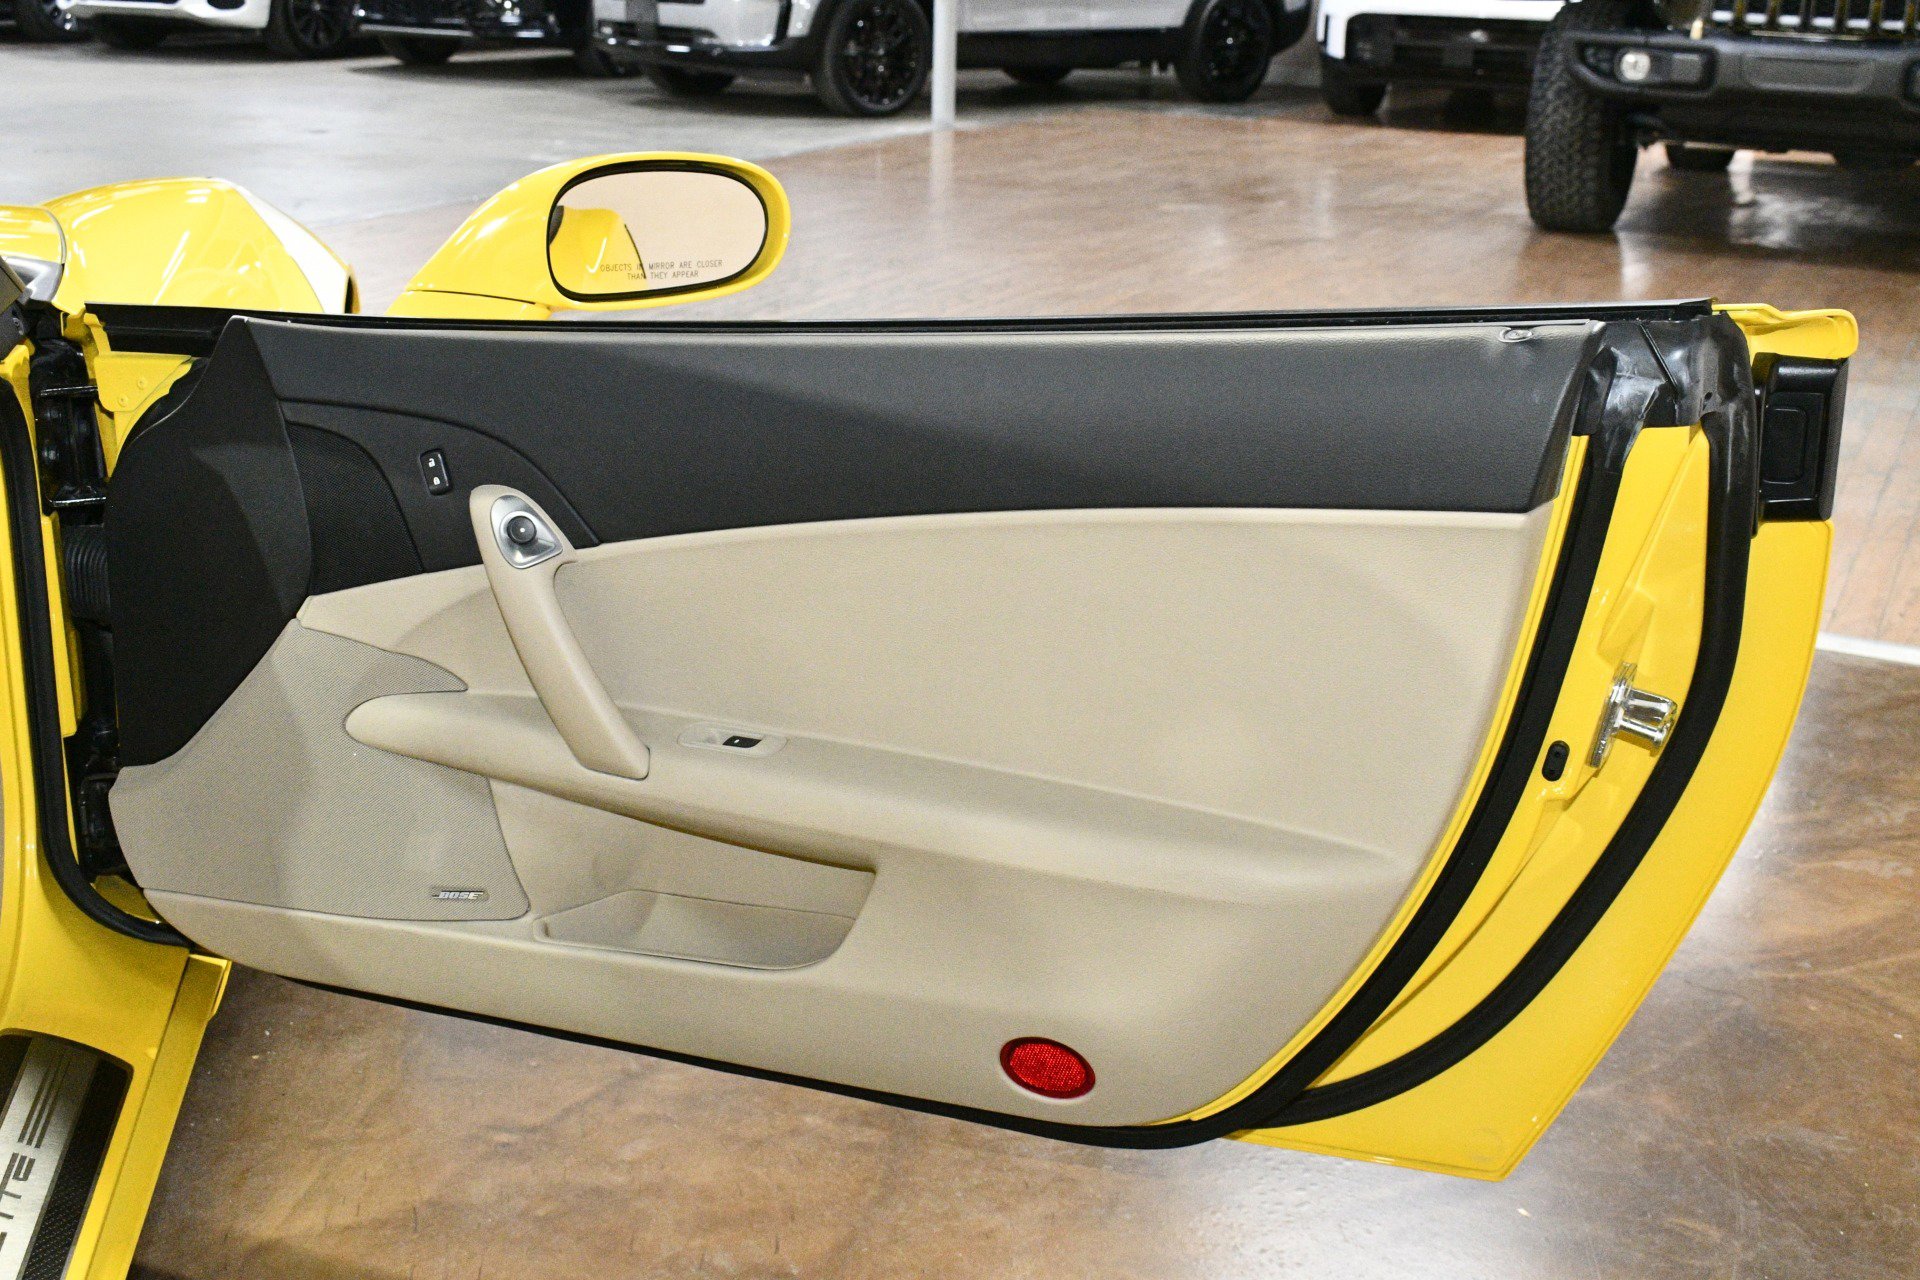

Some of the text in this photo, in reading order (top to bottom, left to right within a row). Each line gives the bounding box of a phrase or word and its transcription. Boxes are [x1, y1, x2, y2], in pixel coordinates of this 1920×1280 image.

[600, 263, 632, 272] OBJECTS
[648, 261, 675, 270] MIRROR
[679, 260, 693, 269] ARE
[696, 259, 723, 268] CLOSER
[627, 269, 699, 280] THAN THEY APPEAR
[432, 890, 484, 900] BOSE
